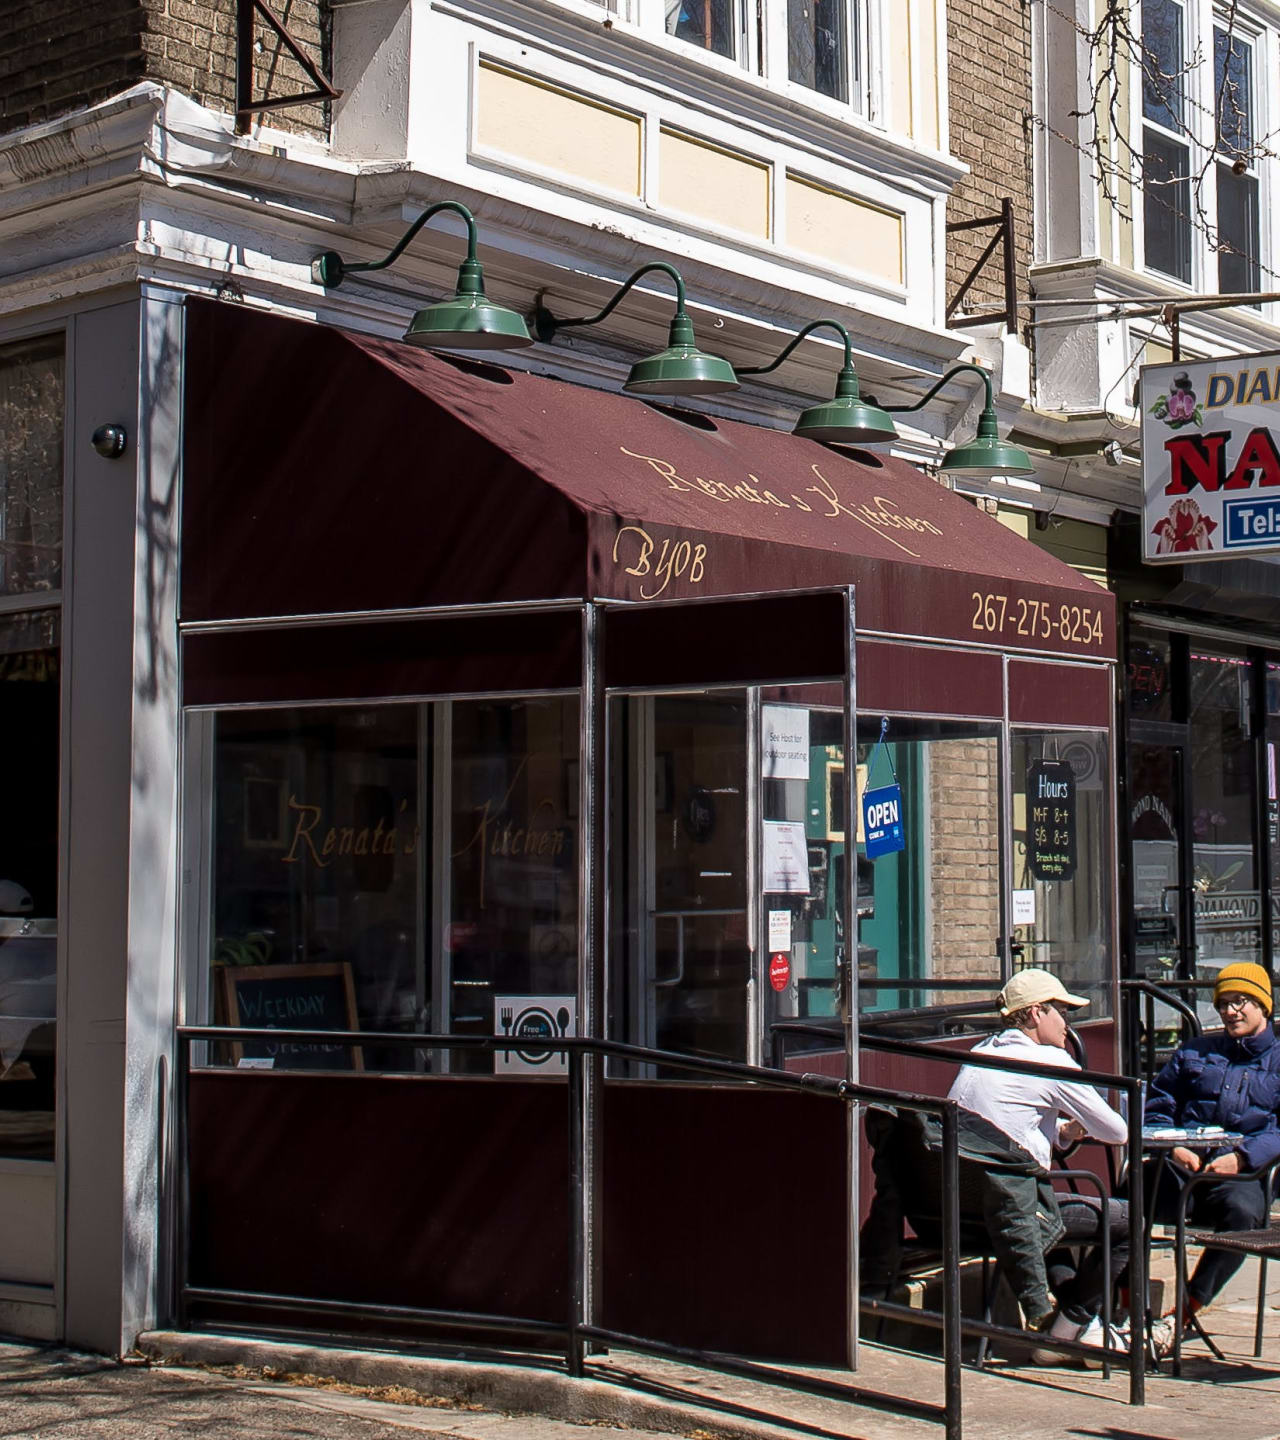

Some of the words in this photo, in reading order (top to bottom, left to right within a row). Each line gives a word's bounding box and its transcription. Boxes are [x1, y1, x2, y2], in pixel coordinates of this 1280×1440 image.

[806, 464, 944, 557] Kitchen
[1238, 509, 1280, 536] Tel:
[613, 526, 707, 600] BYOB
[972, 592, 1104, 645] 267-275-8254
[1038, 774, 1069, 798] Hours
[867, 799, 899, 829] OPEN
[1033, 807, 1049, 822] M-F
[1054, 807, 1069, 824] 8-4
[280, 793, 420, 868] Renata's
[451, 751, 566, 910] Kitchen
[1053, 829, 1069, 845] 8-5
